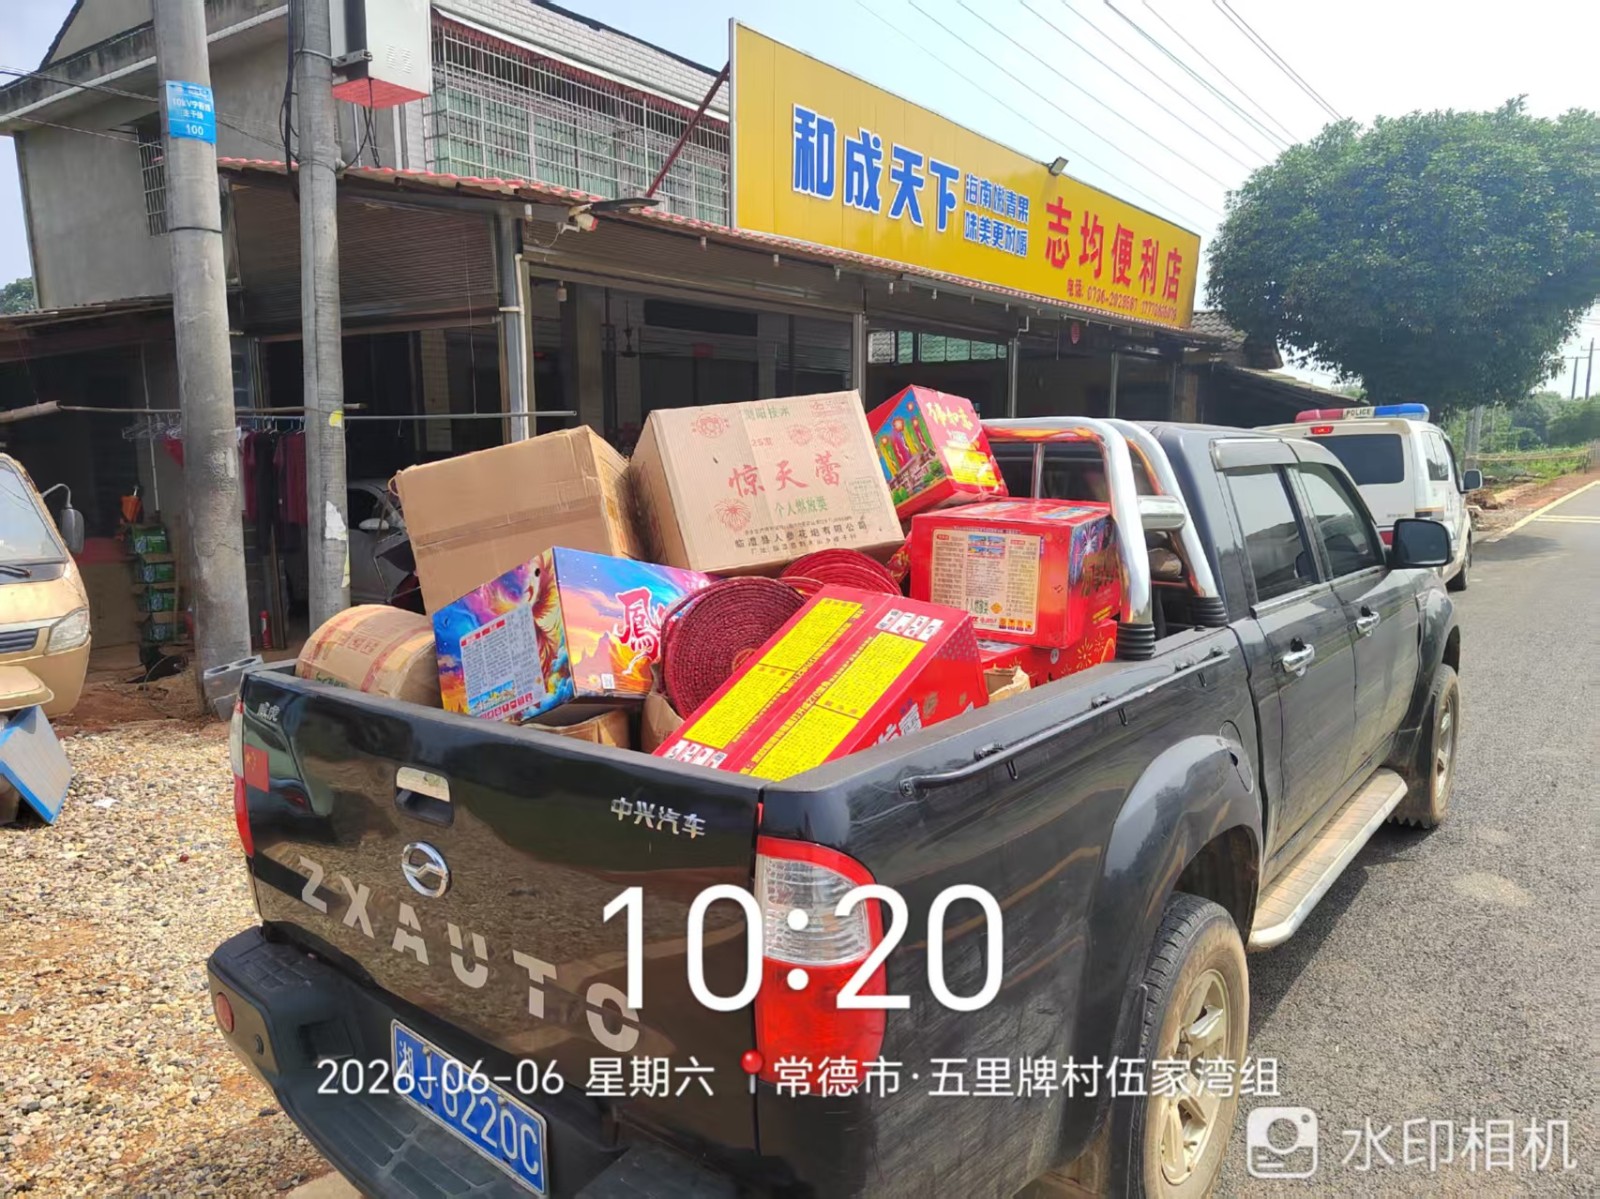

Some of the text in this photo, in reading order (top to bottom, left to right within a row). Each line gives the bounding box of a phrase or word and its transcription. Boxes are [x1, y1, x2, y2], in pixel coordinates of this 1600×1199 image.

[186, 123, 204, 136] 100
[792, 103, 960, 232] 和成天下
[1044, 195, 1184, 303] 志均便利店
[1346, 408, 1373, 417] POLICE
[610, 797, 706, 839] 中兴汽车
[299, 857, 641, 1053] ZXAUTO
